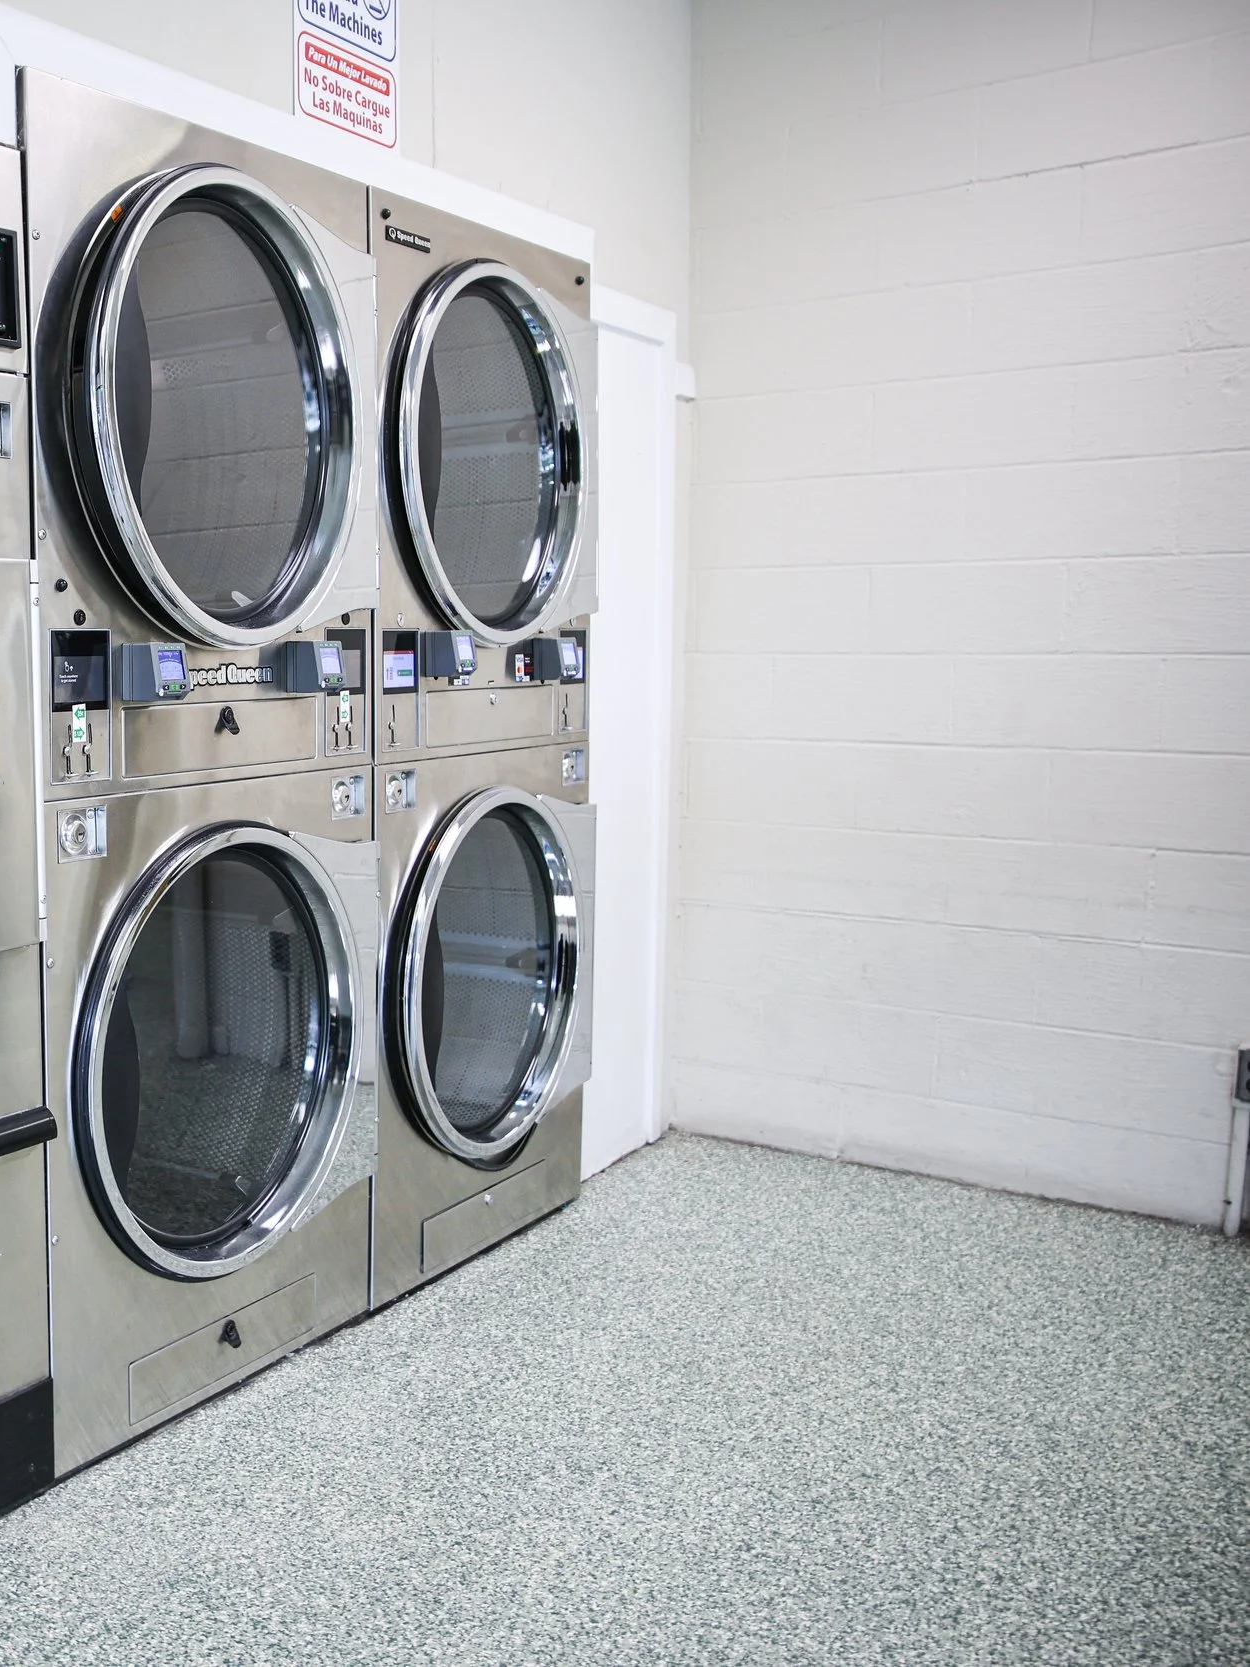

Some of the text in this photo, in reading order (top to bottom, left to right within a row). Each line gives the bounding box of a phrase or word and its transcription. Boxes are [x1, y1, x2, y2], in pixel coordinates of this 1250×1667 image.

[329, 1, 383, 46] Machines
[308, 46, 387, 91] Para Un Mejor Lavado
[304, 67, 390, 118] No Sobre Cargue
[312, 91, 383, 134] Las Maquinas
[189, 663, 273, 691] peed Queen
